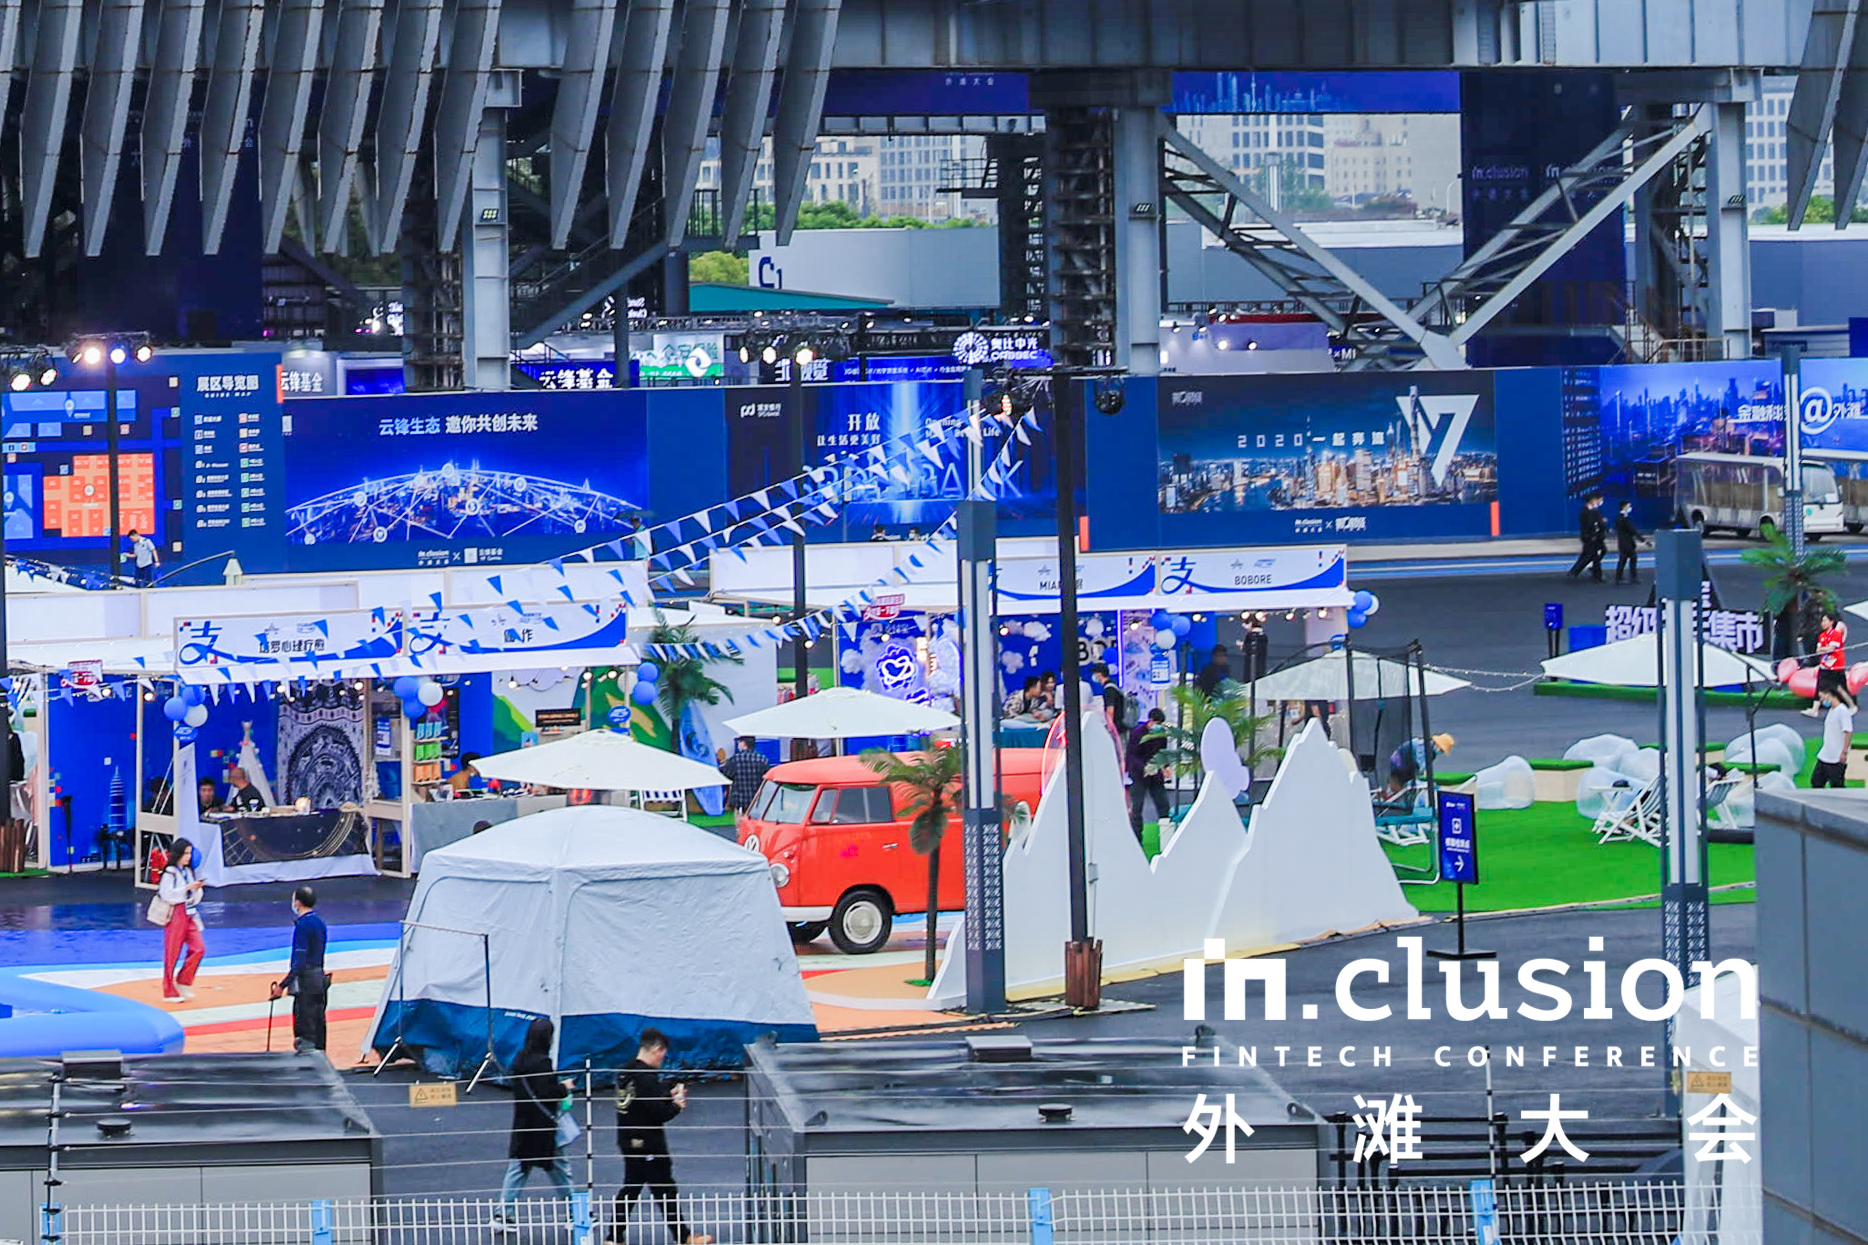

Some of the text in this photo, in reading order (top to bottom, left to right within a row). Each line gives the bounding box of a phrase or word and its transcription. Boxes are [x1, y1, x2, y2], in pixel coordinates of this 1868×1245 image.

[758, 256, 783, 290] C1
[379, 413, 539, 436] 云锋生态 邀你共创未来
[848, 413, 880, 431] 开放
[1237, 434, 1303, 448] 2020
[1234, 574, 1272, 586] BOBORE
[1606, 605, 1764, 652] 超级集市
